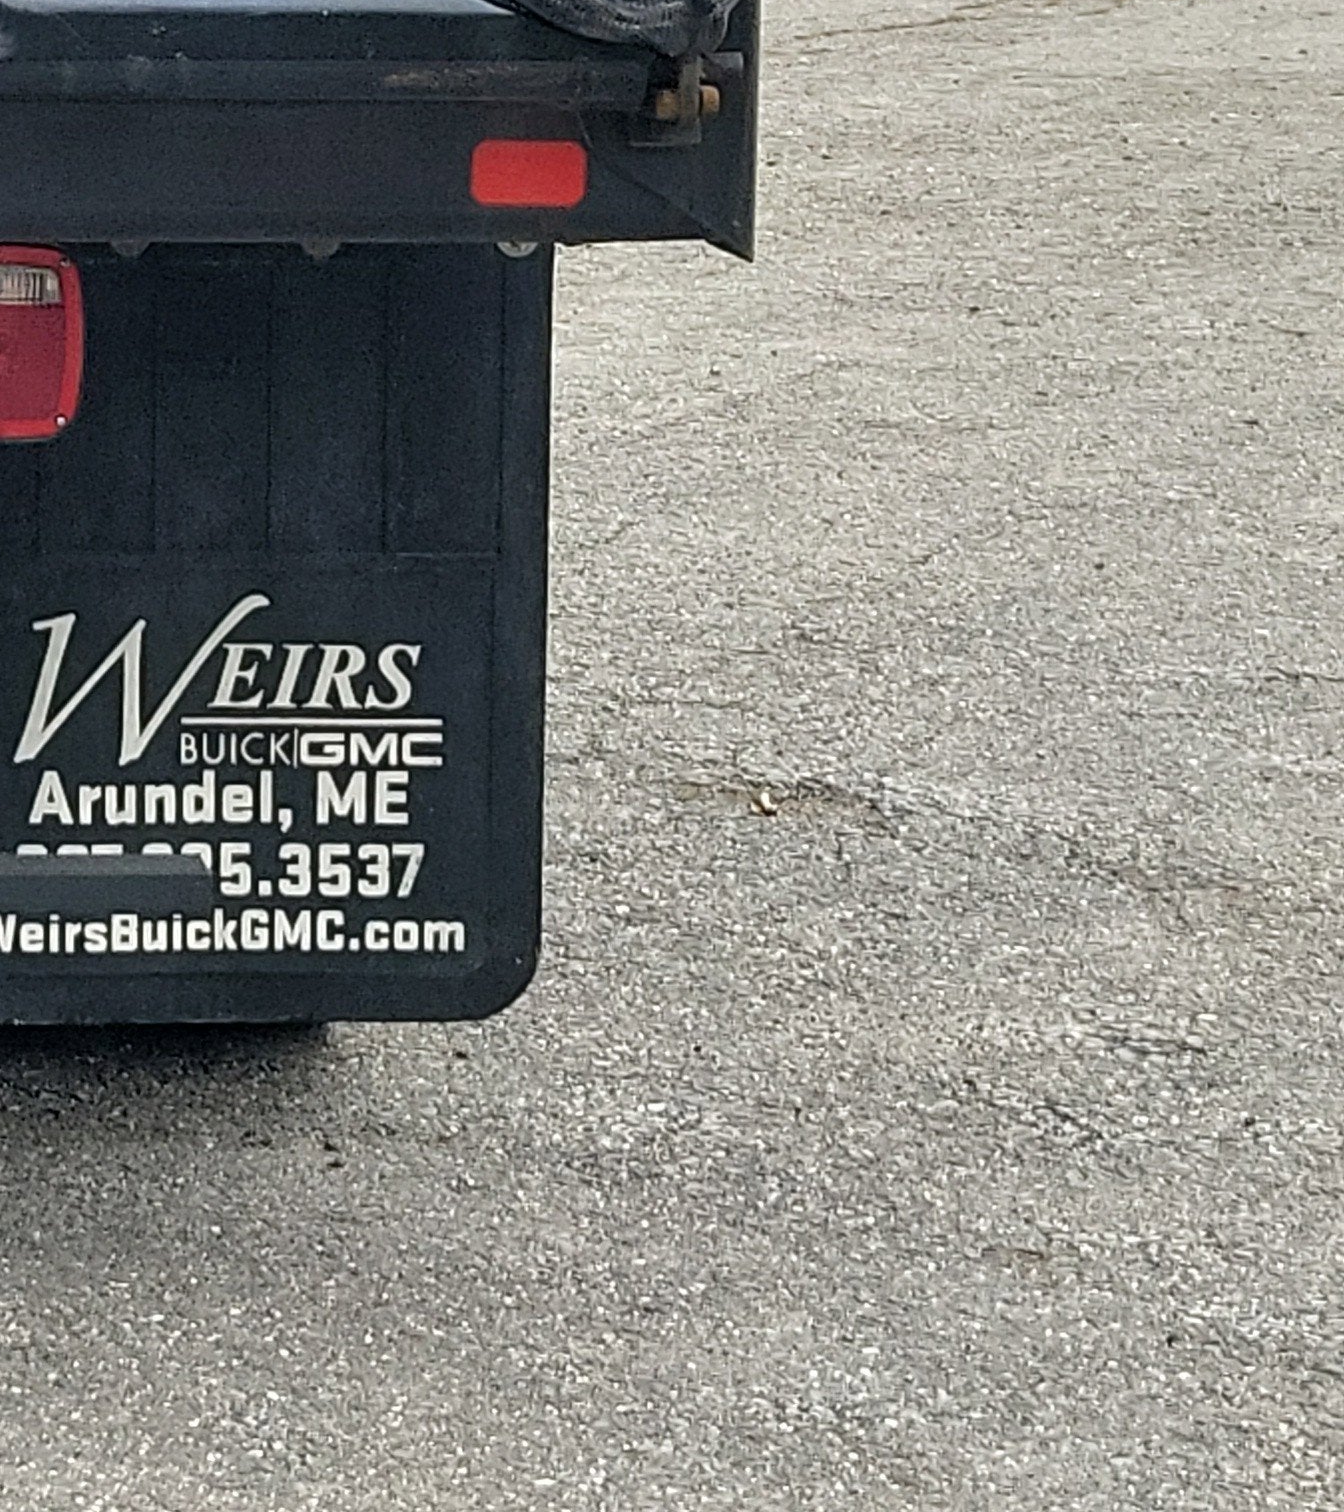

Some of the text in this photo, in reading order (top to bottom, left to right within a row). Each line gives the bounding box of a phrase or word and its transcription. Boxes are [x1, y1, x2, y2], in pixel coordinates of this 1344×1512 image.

[13, 594, 422, 766] WEIRS
[29, 769, 409, 833] Arundel, ME
